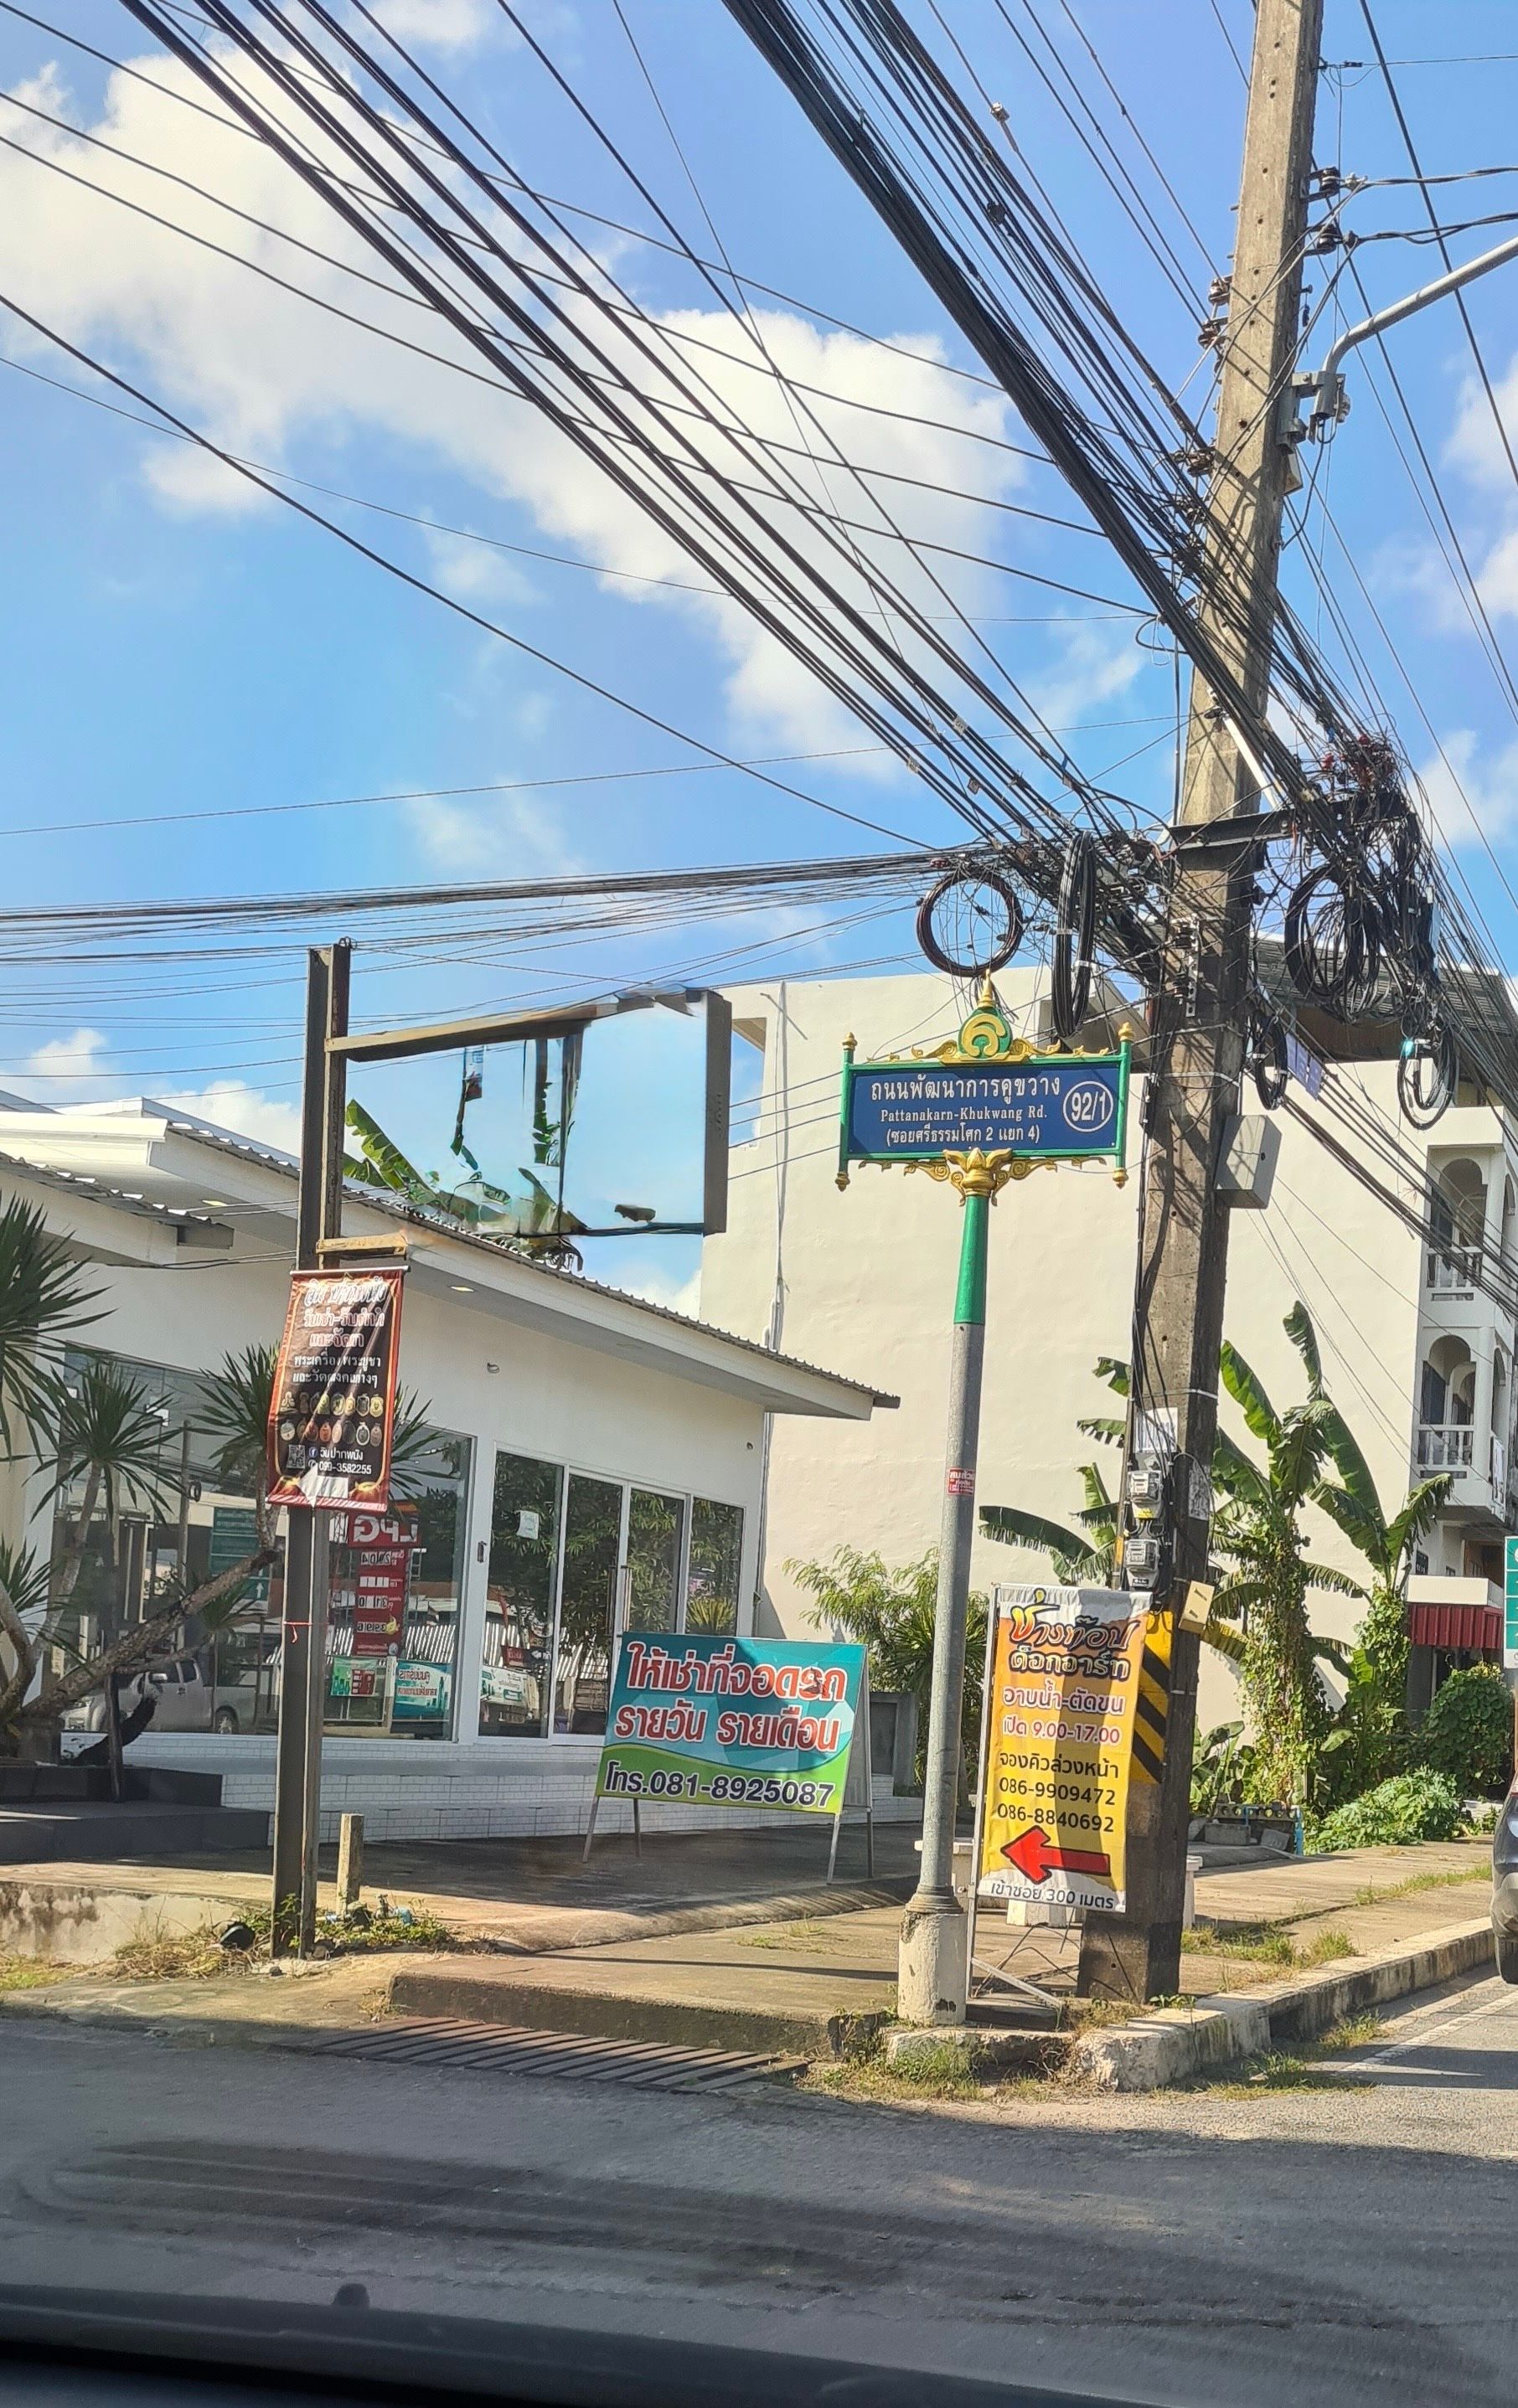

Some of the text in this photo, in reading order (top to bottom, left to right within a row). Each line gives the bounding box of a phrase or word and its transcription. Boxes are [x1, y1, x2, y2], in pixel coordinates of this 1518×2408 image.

[871, 1074, 1060, 1104] ถนนพัฒนาการคูขวาง
[880, 1105, 1048, 1122] Pattanakarn-Khukwang Rd.
[1071, 1091, 1107, 1121] 92/1
[886, 1122, 1040, 1147] (ซอยศรีธรรมโศก 2 แยก 4)
[627, 1640, 848, 1701] ให้เช่าที่จอดรถ
[1004, 1679, 1125, 1714] อาบน้ำ-ตัดขน
[613, 1699, 841, 1753] รายวัน รายเดือน
[1003, 1715, 1121, 1745] เปิด 9.00-17.00
[999, 1752, 1119, 1779] จองคิวล่วงหน้า
[604, 1760, 836, 1809] โทร.081-8925087
[999, 1776, 1116, 1806] 086-9909472
[997, 1802, 1114, 1833] 086-8840692
[1046, 1889, 1076, 1905] 300
[1079, 1894, 1114, 1909] เมตร
